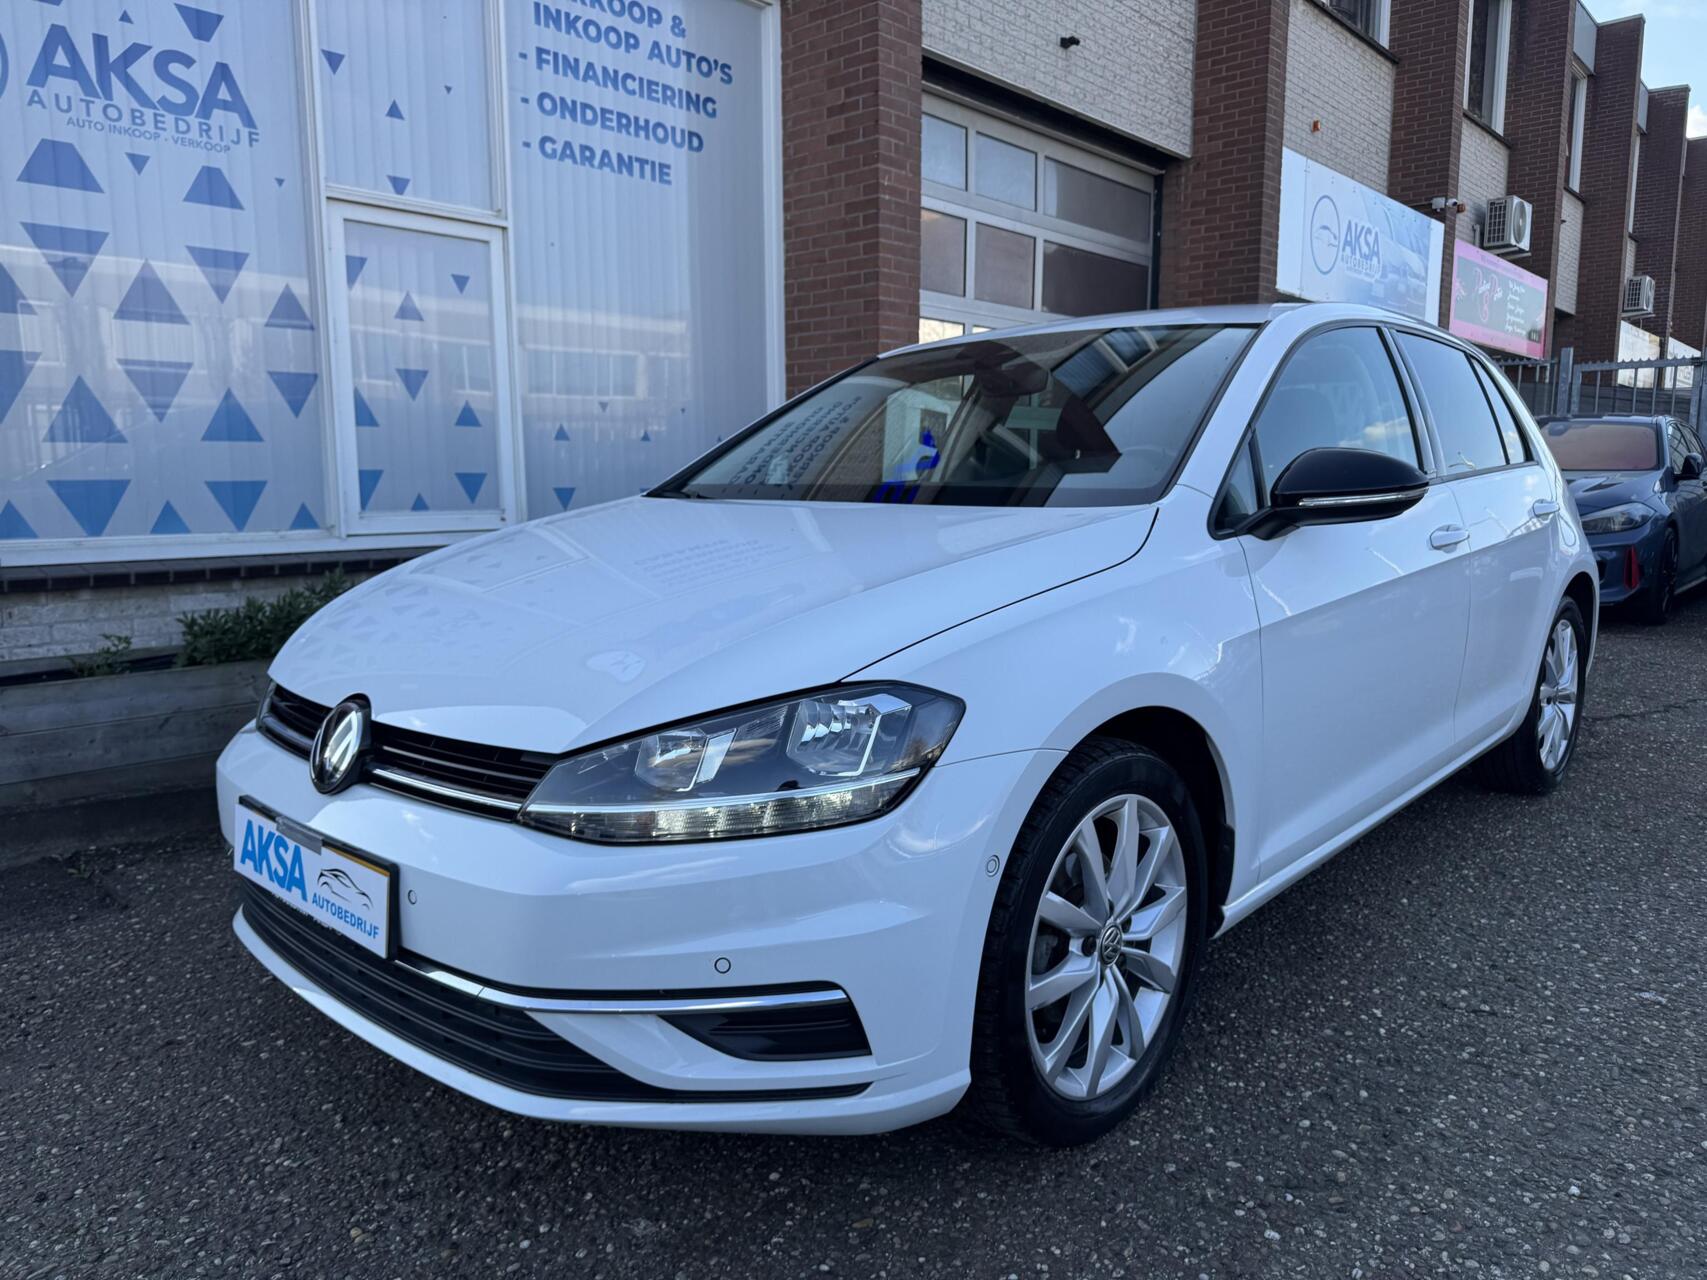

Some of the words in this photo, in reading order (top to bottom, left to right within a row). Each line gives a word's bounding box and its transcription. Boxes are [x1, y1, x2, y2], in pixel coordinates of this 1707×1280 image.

[534, 2, 640, 54] INKOOP
[648, 40, 733, 85] AUTO'S
[670, 15, 687, 38] &
[26, 23, 258, 130] AKSA
[535, 46, 717, 118] FINANCIERING
[27, 88, 260, 148] AUTOBEDRIJF
[66, 117, 104, 132] AUTO
[109, 124, 161, 142] INKOOP
[172, 135, 231, 153] VERKOOP
[537, 92, 704, 153] ONDERHOUD
[538, 135, 672, 185] GARANTIE
[1341, 219, 1380, 265] AKSA
[240, 819, 307, 902] AKSA
[311, 892, 380, 939] AUTOBEDRIJF
